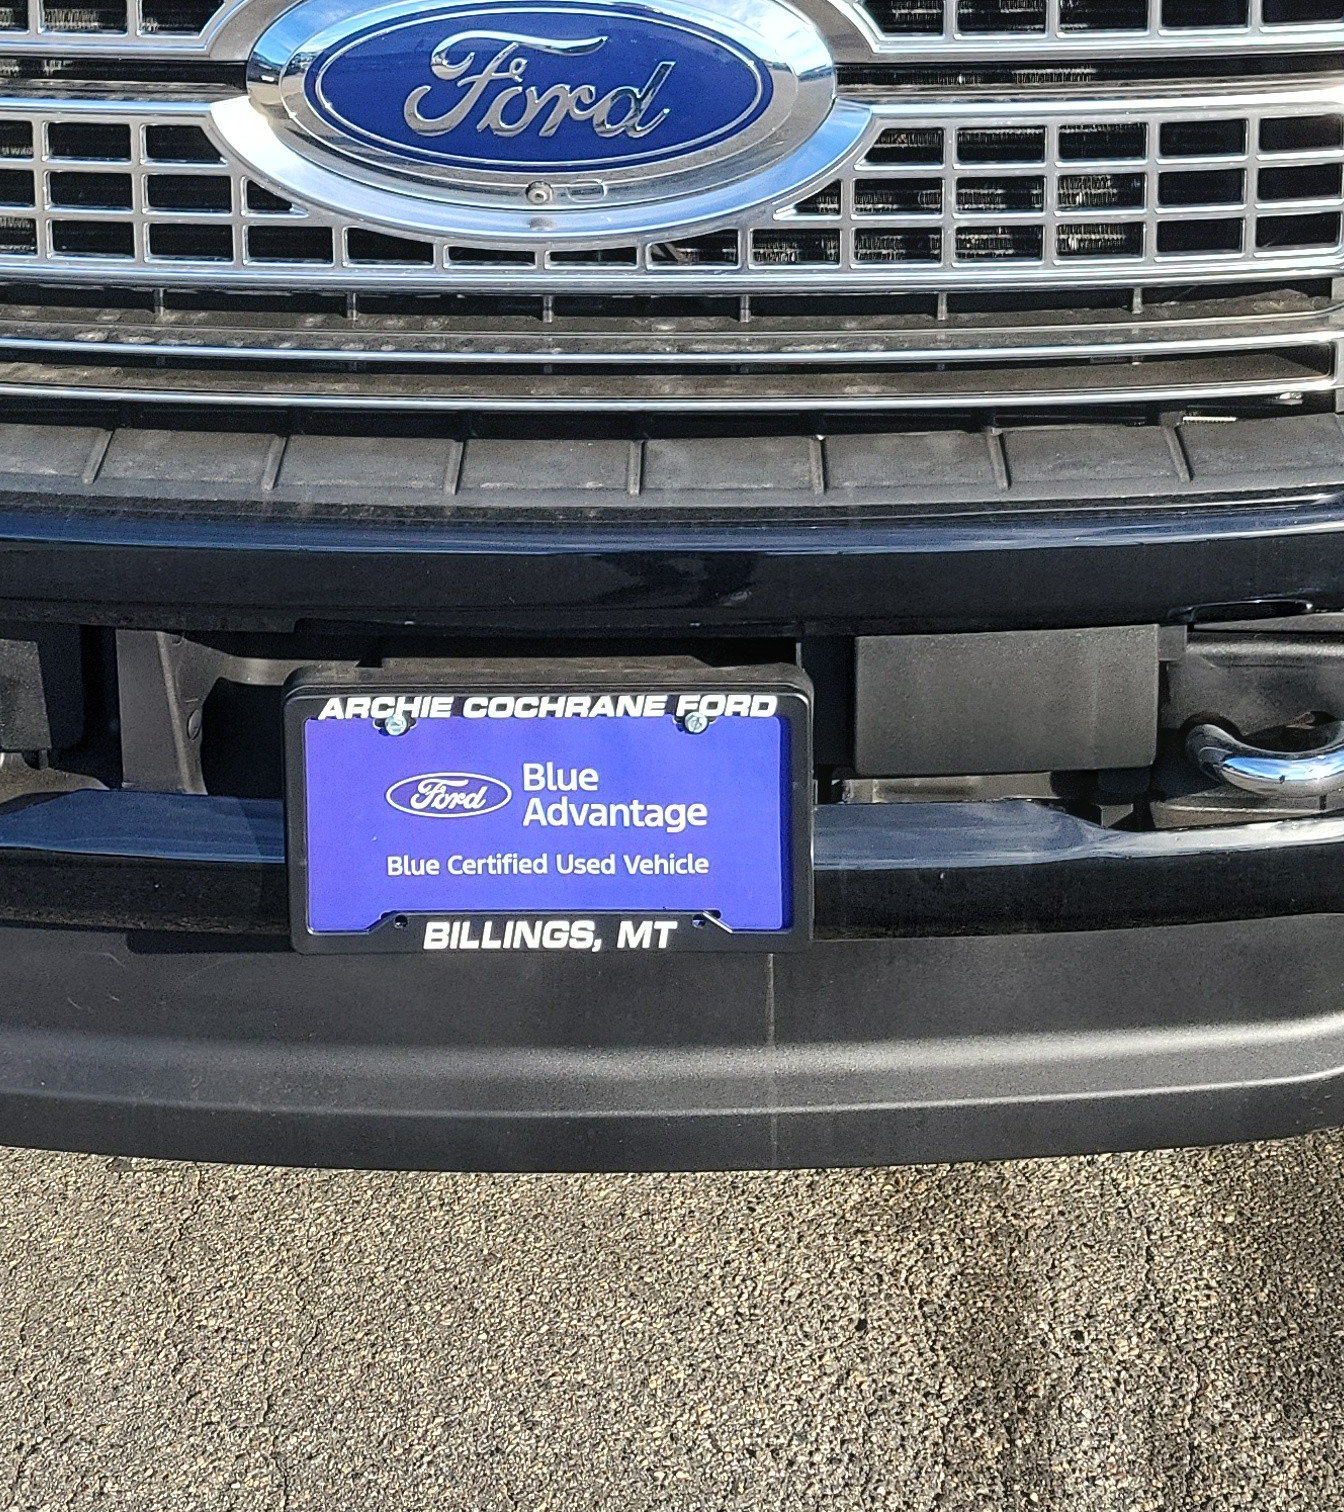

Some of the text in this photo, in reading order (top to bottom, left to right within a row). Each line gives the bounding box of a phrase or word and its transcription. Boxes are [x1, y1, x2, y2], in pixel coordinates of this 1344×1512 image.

[404, 29, 675, 138] Ford
[318, 694, 778, 720] ARCHIE COCHRANE FORD
[522, 762, 599, 792] Blue
[410, 779, 487, 811] Ford
[522, 797, 708, 833] Advantage
[387, 853, 710, 876] Blue Certified Used Vehicle
[423, 920, 677, 953] BILLINGS, MT
